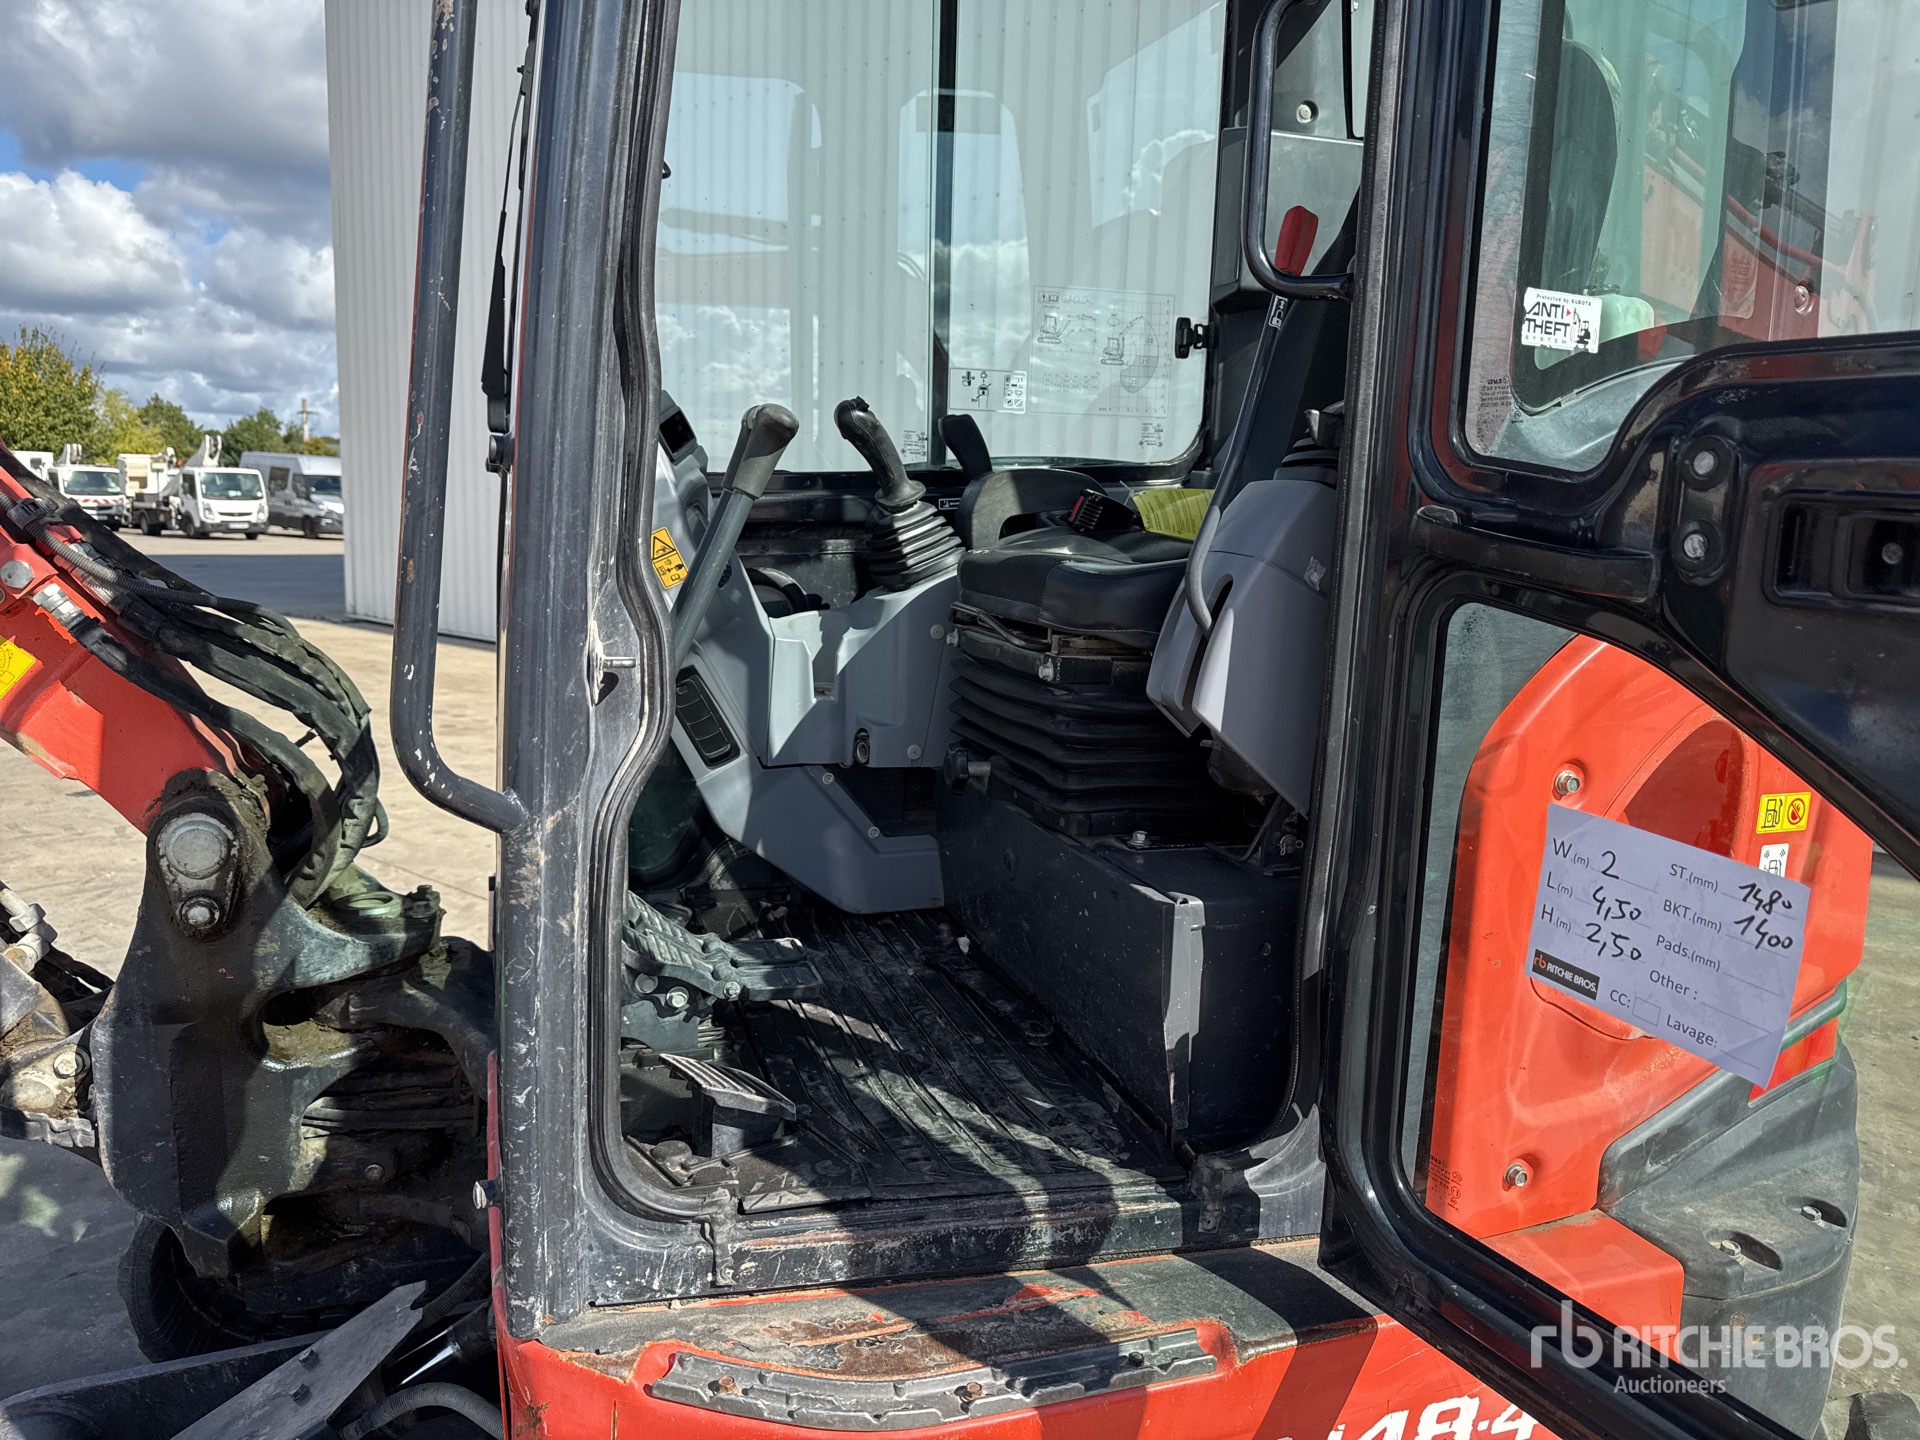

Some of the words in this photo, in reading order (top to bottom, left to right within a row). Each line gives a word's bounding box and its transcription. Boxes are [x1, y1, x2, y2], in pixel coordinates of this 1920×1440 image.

[1527, 302, 1565, 319] ANTI
[1536, 294, 1561, 302] Protected
[1571, 298, 1592, 307] KUBOTA
[1525, 318, 1570, 337] THEFT
[1525, 335, 1567, 344] SYSTEM
[1552, 837, 1590, 869] W.(m)
[1600, 850, 1620, 880] 2
[1546, 871, 1573, 898] L.(m)
[1669, 863, 1719, 892] ST.(mm)
[1592, 885, 1642, 922] 4,50
[1738, 881, 1793, 914] 1480
[1541, 904, 1572, 933] H.(m)
[1663, 899, 1722, 933] BKT.(mm)
[1585, 922, 1642, 961] 2,50
[1733, 914, 1794, 950] 1400
[1656, 934, 1721, 972] Pads.(mm)
[1547, 961, 1574, 982] RITCHIE
[1574, 974, 1597, 993] BROS.
[1649, 969, 1690, 996] Other
[1609, 989, 1631, 1008] CC:
[1666, 1014, 1718, 1048] Lavage:
